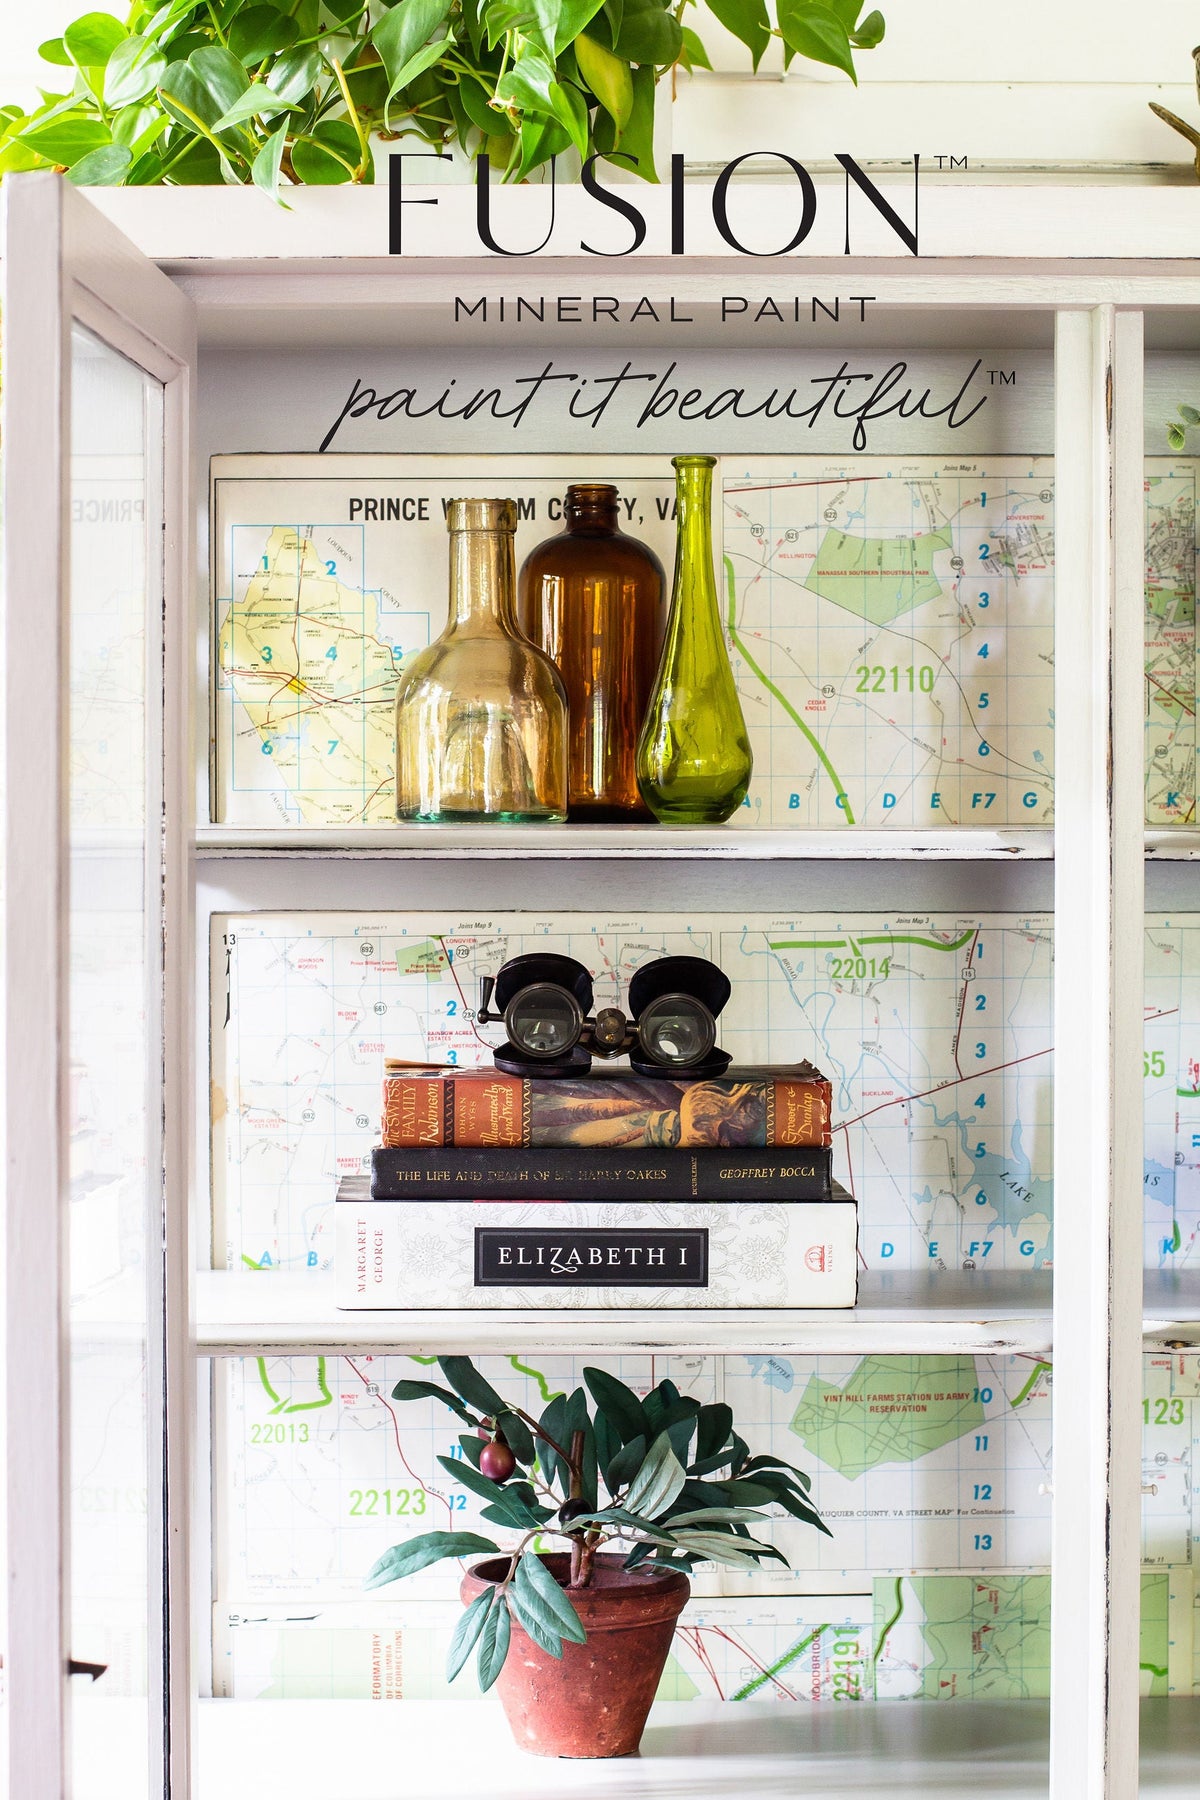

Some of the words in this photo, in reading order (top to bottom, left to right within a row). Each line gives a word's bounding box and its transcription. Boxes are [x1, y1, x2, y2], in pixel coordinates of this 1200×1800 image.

[980, 492, 987, 508] 1
[349, 497, 429, 521] PRINCE
[327, 537, 353, 562] LOUDOUN
[979, 543, 990, 560] 2
[262, 555, 268, 570] 1
[325, 560, 336, 575] 2
[379, 587, 403, 609] COUNTY
[978, 592, 989, 609] 3
[261, 646, 273, 662] 3
[325, 646, 337, 661] 4
[392, 646, 403, 661] 5
[977, 643, 989, 659] 4
[855, 666, 934, 693] 22110
[978, 693, 989, 709] 5
[261, 740, 273, 755] 6
[327, 740, 339, 755] 7
[978, 741, 990, 757] 6
[740, 793, 751, 809] A
[788, 793, 801, 809] B
[835, 793, 848, 809] C
[882, 793, 897, 809] D
[930, 793, 941, 809] E
[1022, 792, 1038, 808] G
[1167, 791, 1180, 807] K
[222, 934, 236, 945] 13
[976, 943, 983, 958] 1
[831, 957, 889, 979] 22014
[446, 1000, 458, 1016] 2
[975, 994, 987, 1011] 2
[446, 1050, 458, 1065] 3
[975, 1042, 987, 1059] 3
[387, 1079, 401, 1127] SWISS
[974, 1093, 986, 1109] 4
[401, 1083, 416, 1138] FAMILY
[417, 1082, 441, 1146] Robinson
[459, 1097, 467, 1138] JOHANN
[468, 1100, 477, 1131] WYSS
[799, 1092, 814, 1140] Dunlap
[975, 1142, 986, 1158] 5
[396, 1171, 422, 1181] THE
[426, 1171, 451, 1181] LIFE
[455, 1171, 483, 1181] AND
[487, 1171, 529, 1181] DEATH
[533, 1171, 551, 1181] OF
[626, 1170, 668, 1180] OAKES
[719, 1168, 775, 1179] GEOFFREY
[780, 1167, 815, 1178] BOCCA
[999, 1171, 1035, 1204] LAKE
[975, 1190, 987, 1205] 6
[881, 1242, 894, 1258] D
[928, 1242, 938, 1257] E
[1020, 1240, 1035, 1256] G
[1163, 1239, 1175, 1254] K
[258, 1250, 273, 1266] A
[307, 1250, 318, 1267] B
[357, 1218, 367, 1293] MARGARET
[374, 1229, 383, 1283] GEORGE
[498, 1247, 666, 1274] ELIZABETH
[679, 1247, 688, 1265] I
[767, 1359, 791, 1380] BRITTLE
[823, 1394, 843, 1403] VINT
[845, 1394, 864, 1402] HILL
[867, 1394, 895, 1402] FARMS
[896, 1393, 932, 1401] STATION
[934, 1393, 945, 1401] US
[946, 1392, 970, 1400] ARMY
[973, 1387, 993, 1404] 10
[869, 1405, 928, 1413] RESERVATION
[1142, 1398, 1184, 1425] 123
[251, 1423, 310, 1444] 22013
[975, 1435, 989, 1452] 11
[974, 1484, 993, 1501] 12
[349, 1489, 427, 1516] 22123
[449, 1495, 467, 1511] 12
[816, 1510, 855, 1518] AUQUIER
[893, 1509, 905, 1517] VA
[905, 1509, 933, 1517] STREET
[974, 1534, 993, 1551] 13
[832, 1629, 860, 1700] 22191
